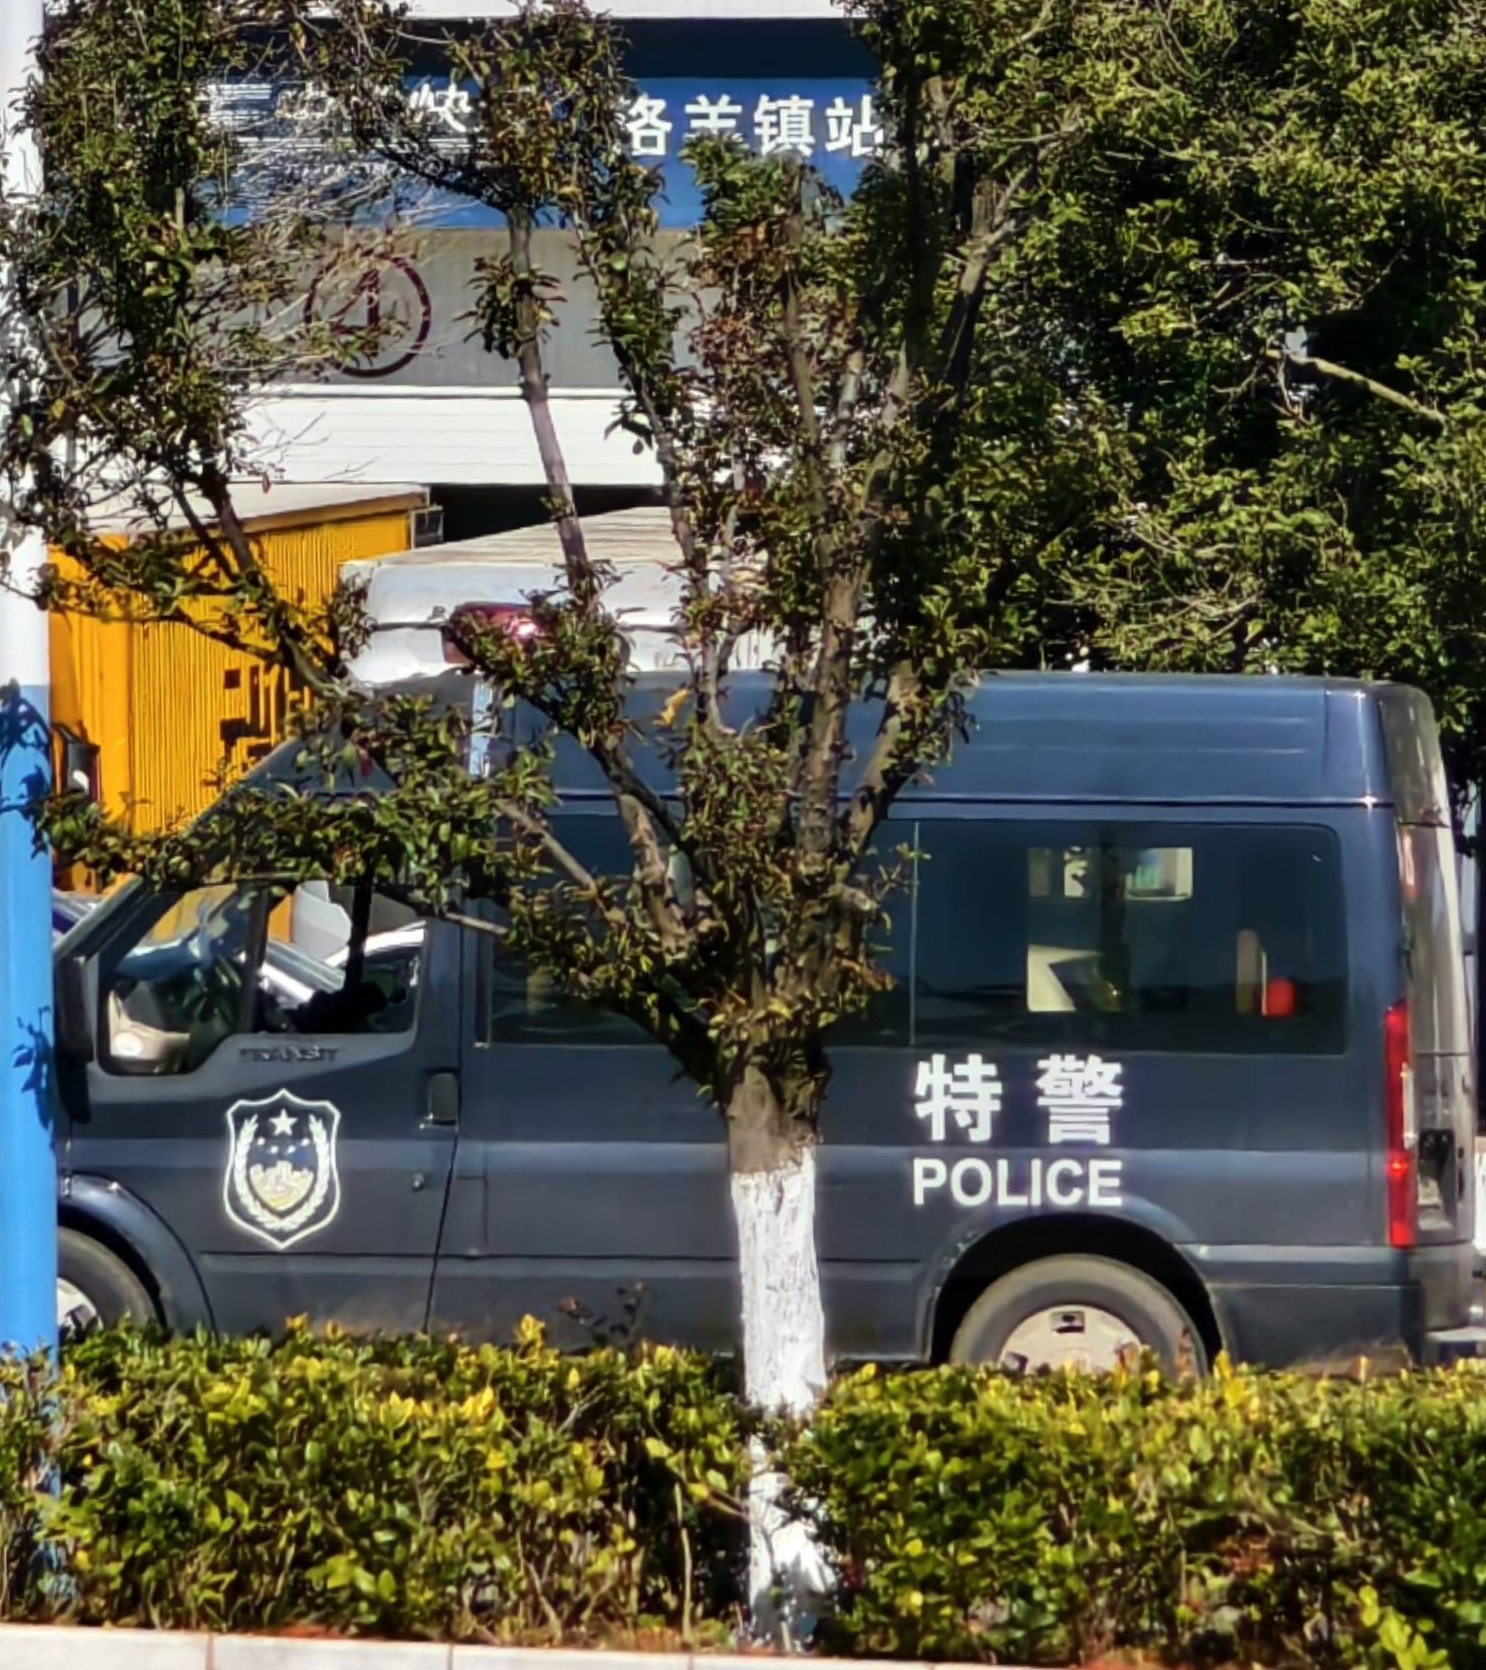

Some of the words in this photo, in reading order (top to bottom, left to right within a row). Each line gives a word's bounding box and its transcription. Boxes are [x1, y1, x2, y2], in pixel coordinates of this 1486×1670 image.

[613, 93, 885, 158] 洛羊镇站
[913, 1052, 1124, 1145] 特警
[912, 1156, 1124, 1208] POLICE
